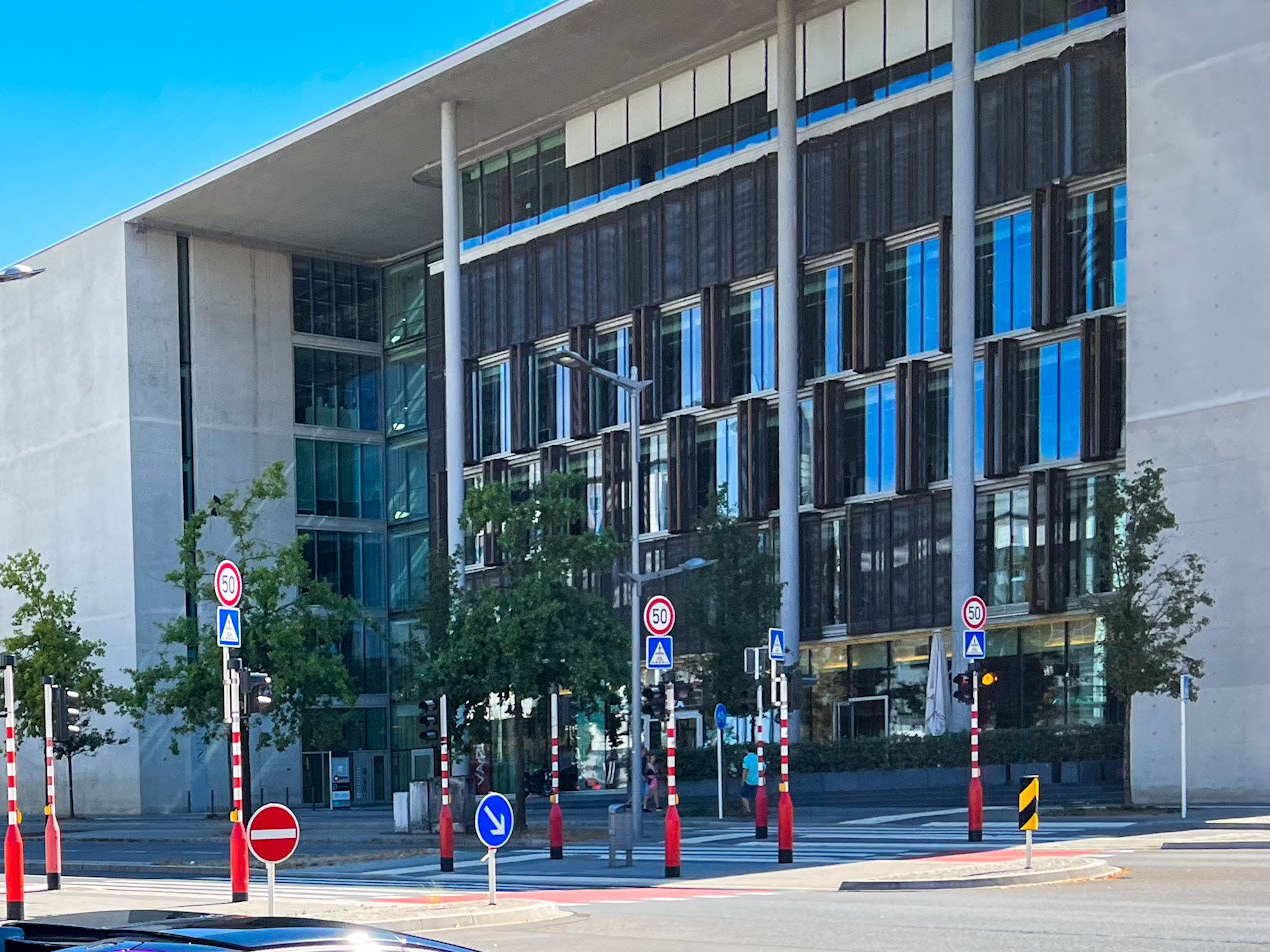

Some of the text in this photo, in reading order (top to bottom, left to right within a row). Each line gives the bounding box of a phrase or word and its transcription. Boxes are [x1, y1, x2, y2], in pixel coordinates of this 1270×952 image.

[222, 574, 236, 594] 50
[652, 608, 668, 624] 50
[968, 606, 981, 620] 50
